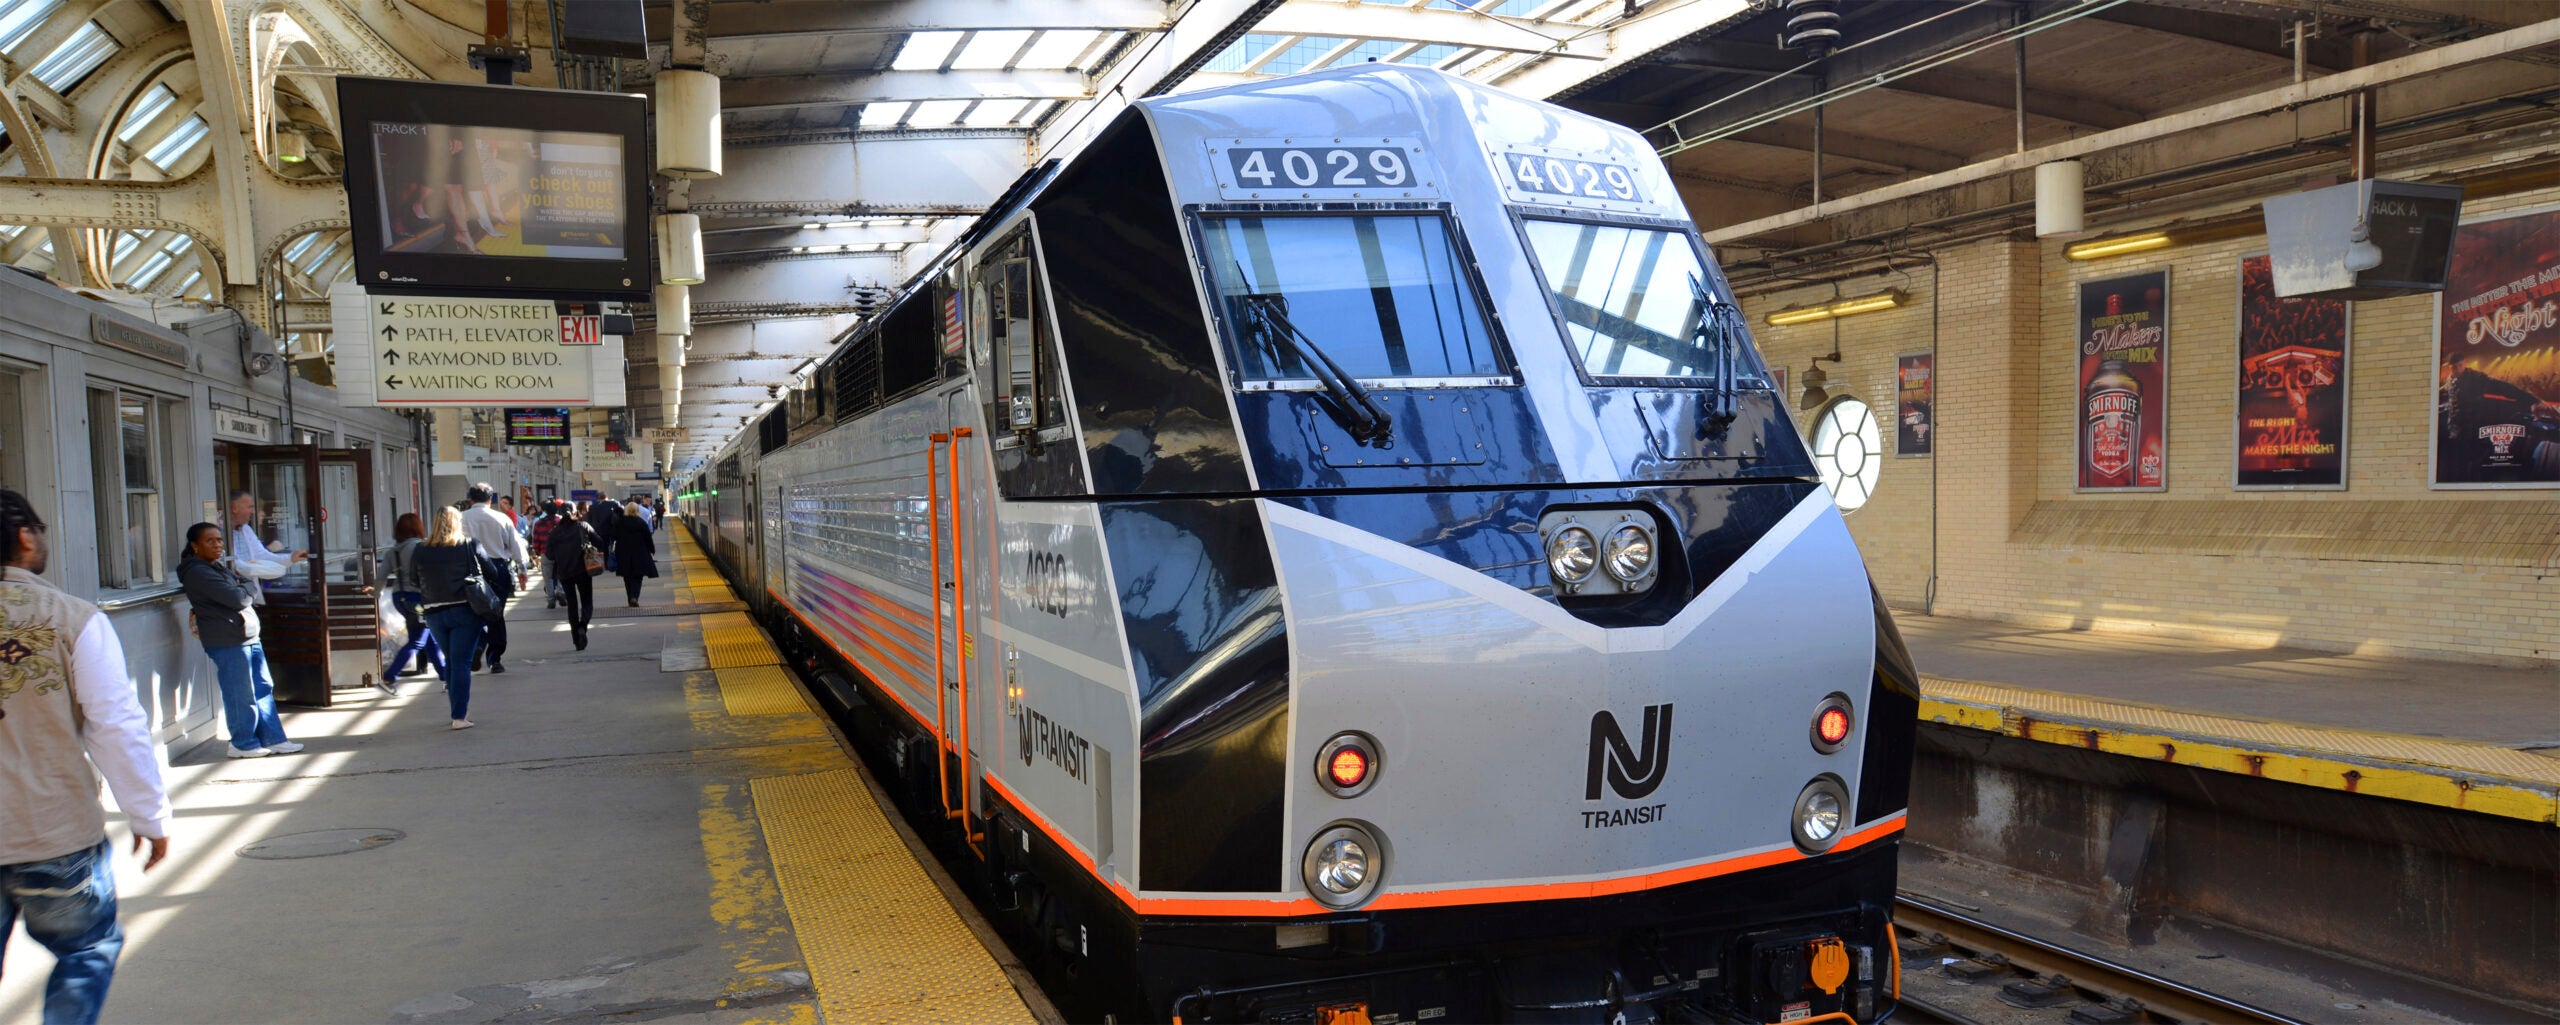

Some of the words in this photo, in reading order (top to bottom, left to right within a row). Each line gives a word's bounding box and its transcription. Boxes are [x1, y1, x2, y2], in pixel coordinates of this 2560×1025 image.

[374, 124, 417, 135] TRACK
[421, 126, 427, 135] 1
[551, 165, 573, 176] don't
[575, 167, 602, 178] forget
[604, 169, 614, 178] to
[1240, 150, 1406, 186] 4029
[530, 174, 580, 192] check
[587, 179, 614, 194] out
[1517, 156, 1634, 200] 4029
[522, 193, 560, 208] your
[566, 193, 614, 210] shoes
[2371, 200, 2406, 216] RACK
[2409, 202, 2418, 216] A
[2452, 300, 2470, 313] THE
[2509, 275, 2537, 293] THE
[404, 304, 551, 320] STATION/STREET
[560, 316, 598, 343] EXIT
[2466, 301, 2557, 347] Night
[406, 327, 458, 345] PATH,
[465, 327, 554, 343] ELEVATOR
[2084, 322, 2162, 355] Makers
[408, 351, 506, 366] RAYMOND
[512, 351, 562, 366] BLVD.
[2128, 346, 2157, 362] MIX
[409, 375, 487, 389] WAITING
[495, 375, 554, 389] ROOM
[2089, 396, 2137, 416] SMIRNOFF
[2249, 418, 2265, 428] THE
[2266, 417, 2296, 428] RIGHT
[2481, 426, 2522, 436] SMIRNOFF
[2256, 424, 2320, 447] Mix
[2244, 445, 2278, 456] MAKES
[2280, 444, 2300, 455] THE
[2302, 443, 2335, 455] NIGHT
[2494, 445, 2509, 454] MIX
[1026, 549, 1068, 619] 4029
[1033, 710, 1089, 785] TRANSIT
[1586, 703, 1673, 800] NJ
[1581, 804, 1667, 829] TRANSIT
